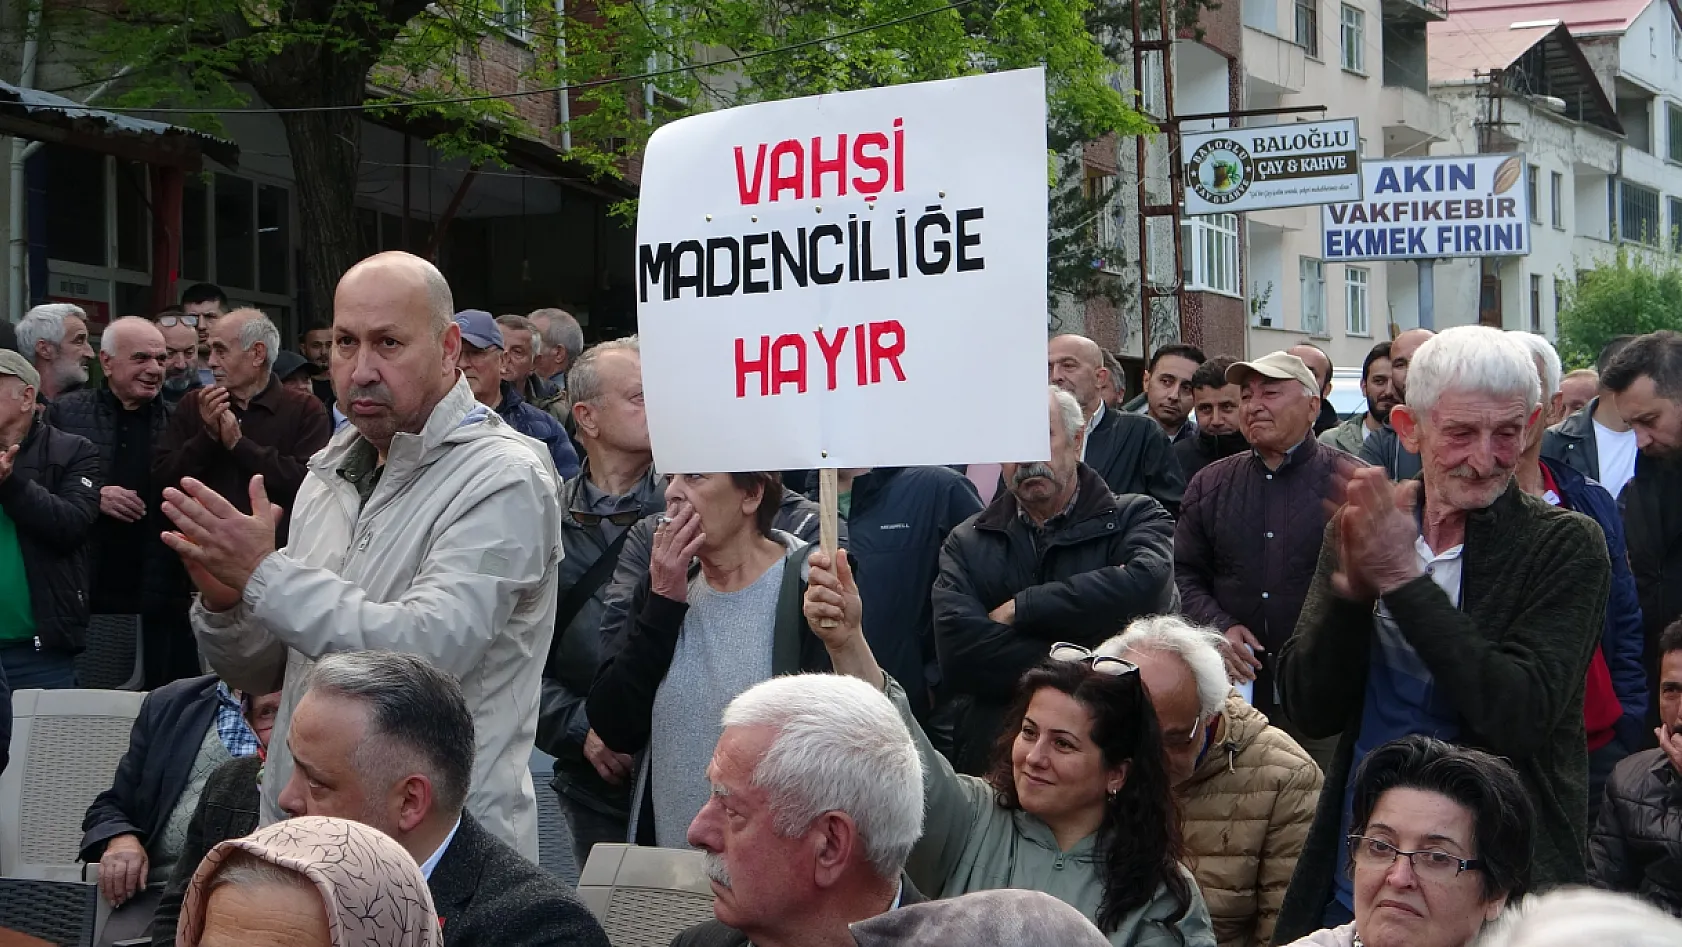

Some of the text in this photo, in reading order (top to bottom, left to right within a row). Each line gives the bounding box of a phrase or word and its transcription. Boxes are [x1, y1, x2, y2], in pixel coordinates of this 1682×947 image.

[1252, 127, 1349, 153] BALOĞLU
[733, 117, 905, 205] VAHŞİ
[1258, 156, 1348, 180] ÇAY & KAHVE
[1374, 163, 1476, 193] AKIN
[1328, 193, 1516, 224] VAKFIKEBİR
[639, 204, 985, 303] MADENCİLİĞE
[1326, 223, 1523, 257] EKMEK FIRINI
[734, 319, 906, 398] HAYIR
